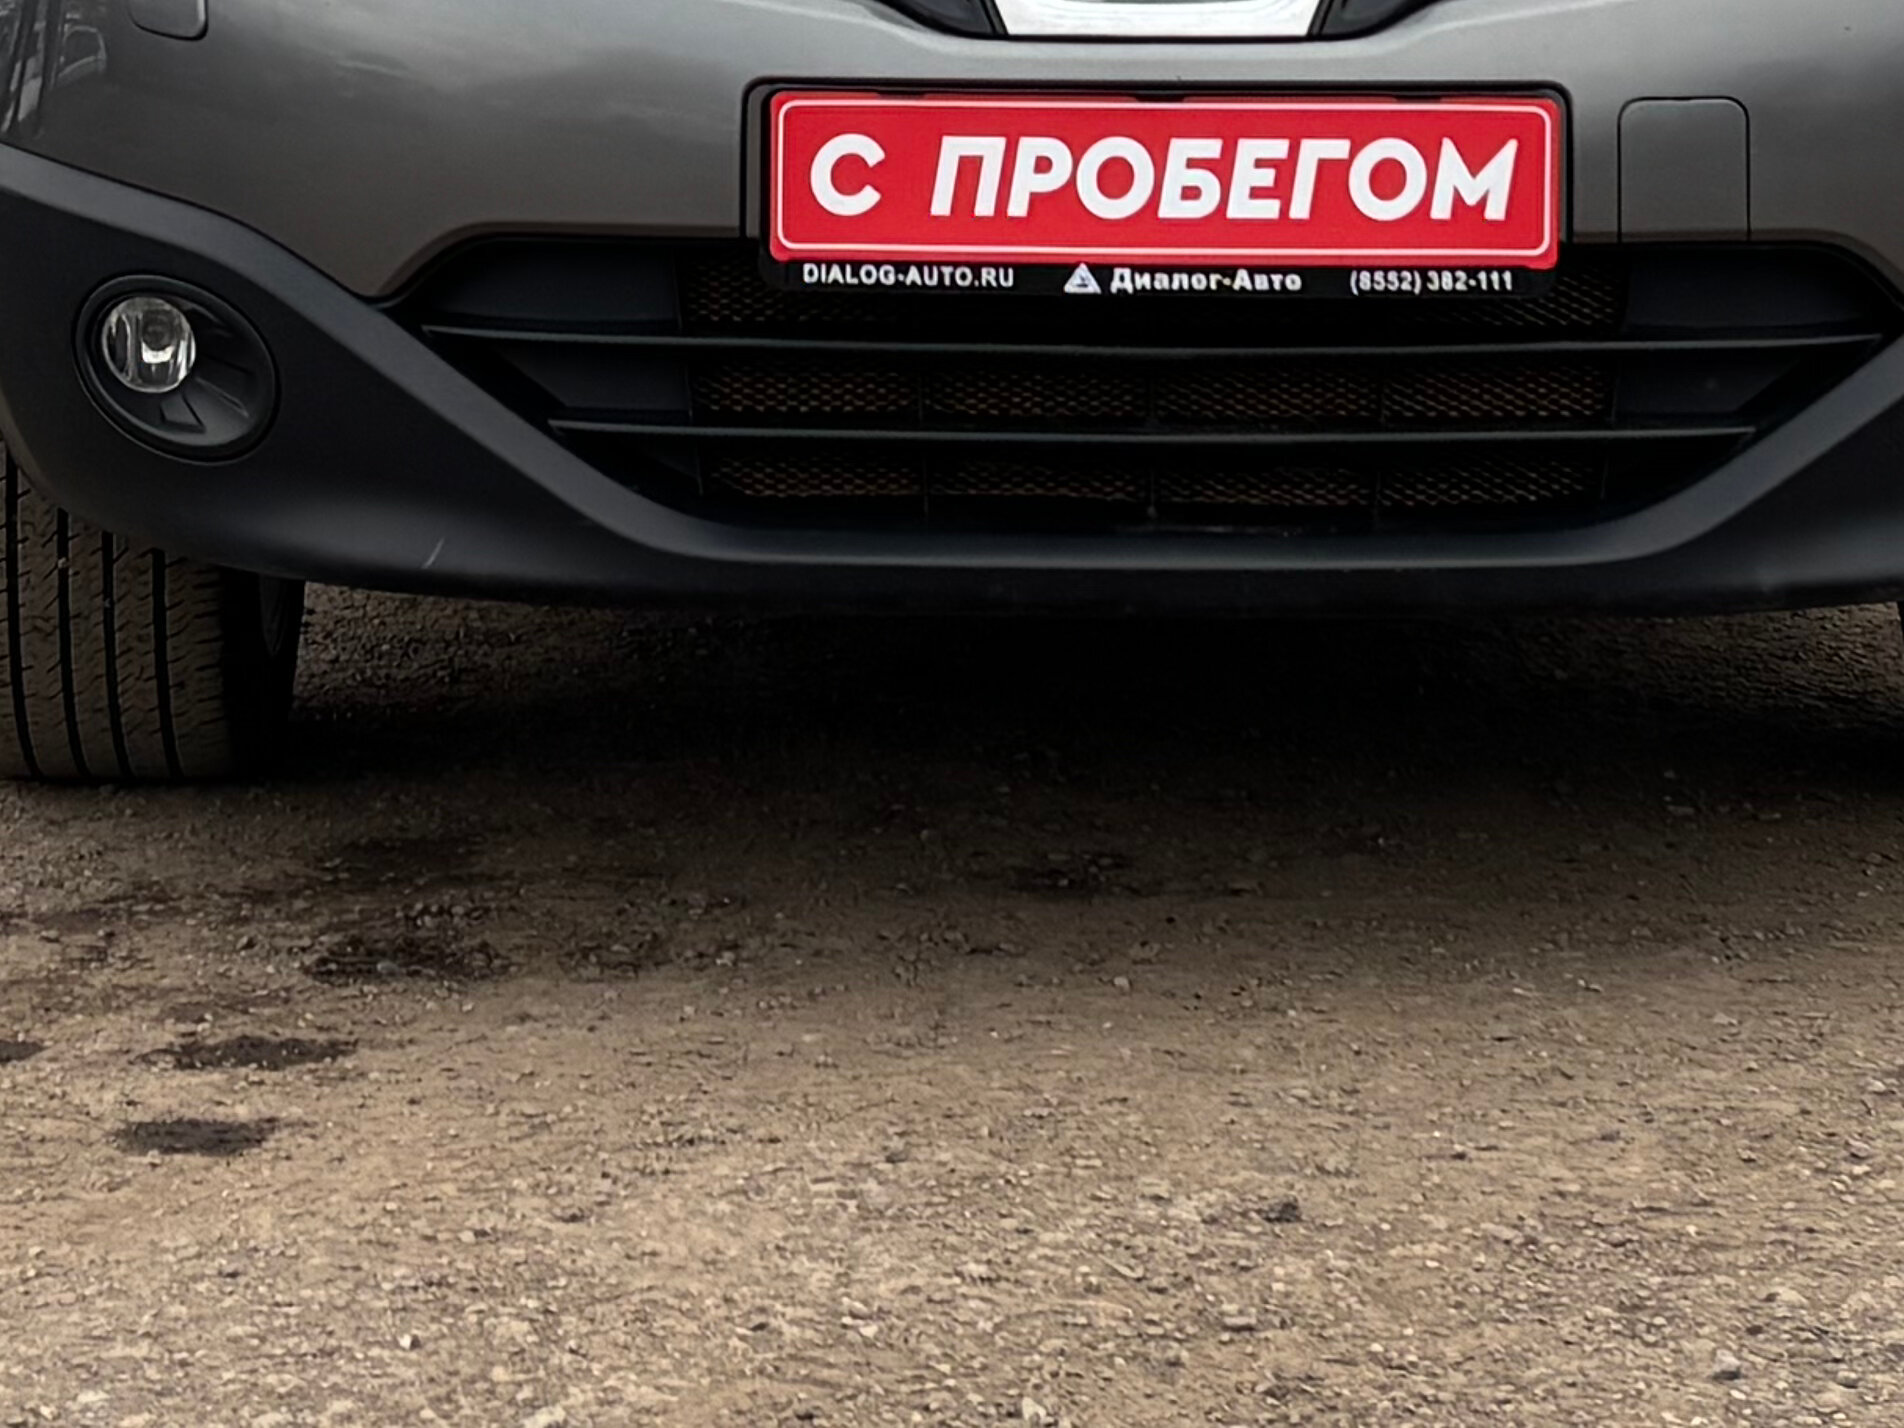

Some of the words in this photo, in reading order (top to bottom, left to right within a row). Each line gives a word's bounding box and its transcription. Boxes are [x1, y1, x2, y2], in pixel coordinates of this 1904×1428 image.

[810, 133, 886, 217] С
[929, 135, 1518, 221] ПРОБЕГОМ
[802, 262, 1015, 288] DIALOG-AUTO.RU
[1110, 266, 1303, 294] Диалог-Авто
[1349, 269, 1422, 296] (8552)
[1427, 270, 1514, 292] 382-111
